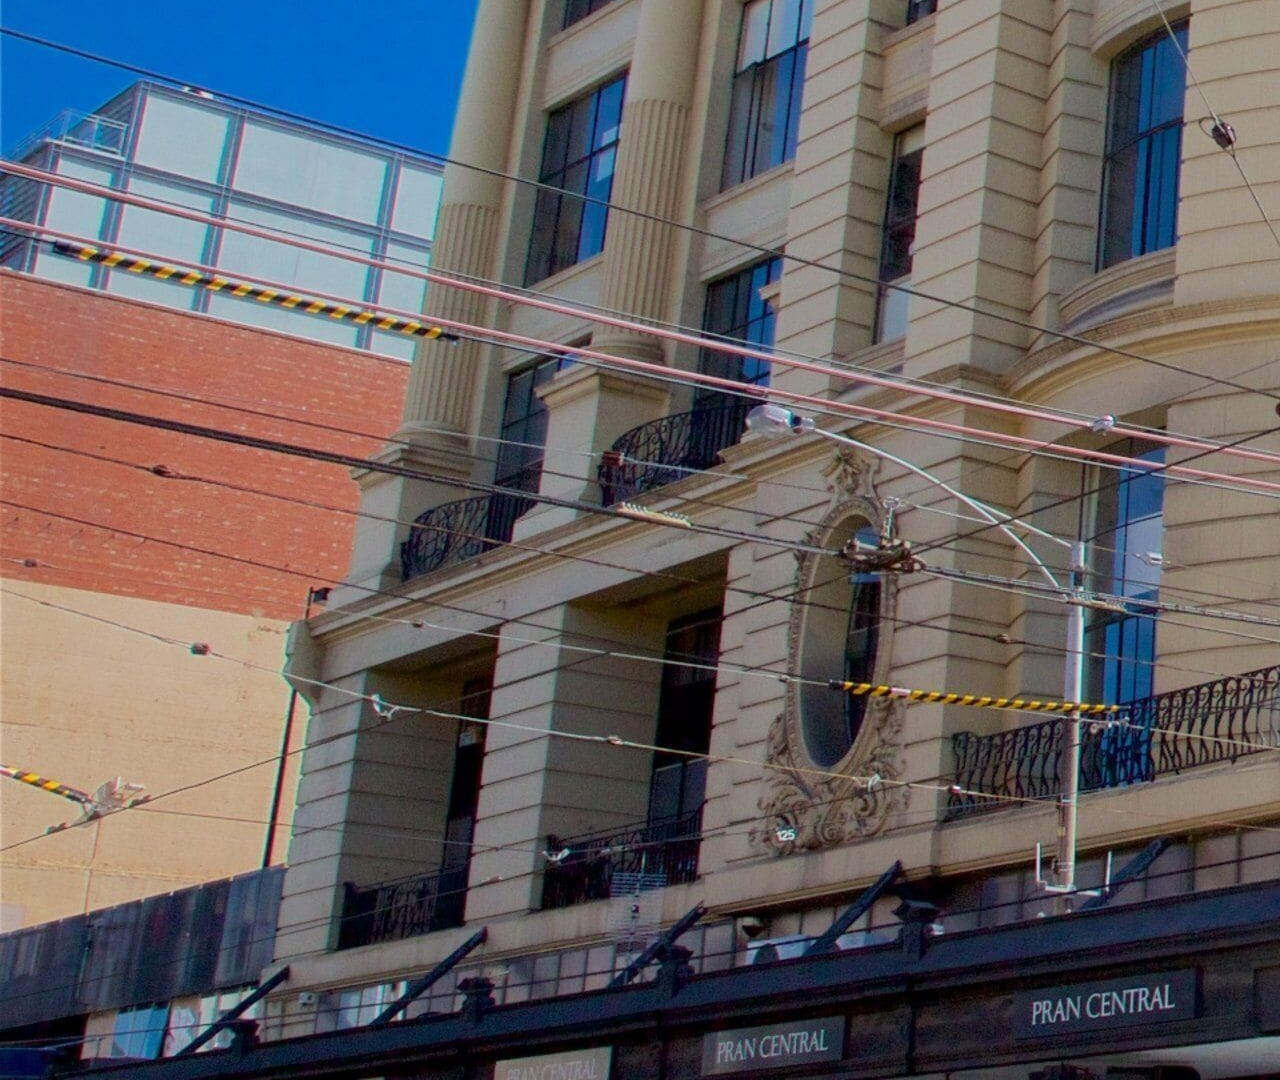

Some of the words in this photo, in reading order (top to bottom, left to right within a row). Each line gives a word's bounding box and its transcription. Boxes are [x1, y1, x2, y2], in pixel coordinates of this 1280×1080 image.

[776, 829, 796, 841] 125
[1032, 996, 1081, 1025] PRAN
[1086, 984, 1175, 1018] CENTRAL
[717, 1036, 756, 1065] PRAN
[759, 1029, 829, 1059] CENTRAL
